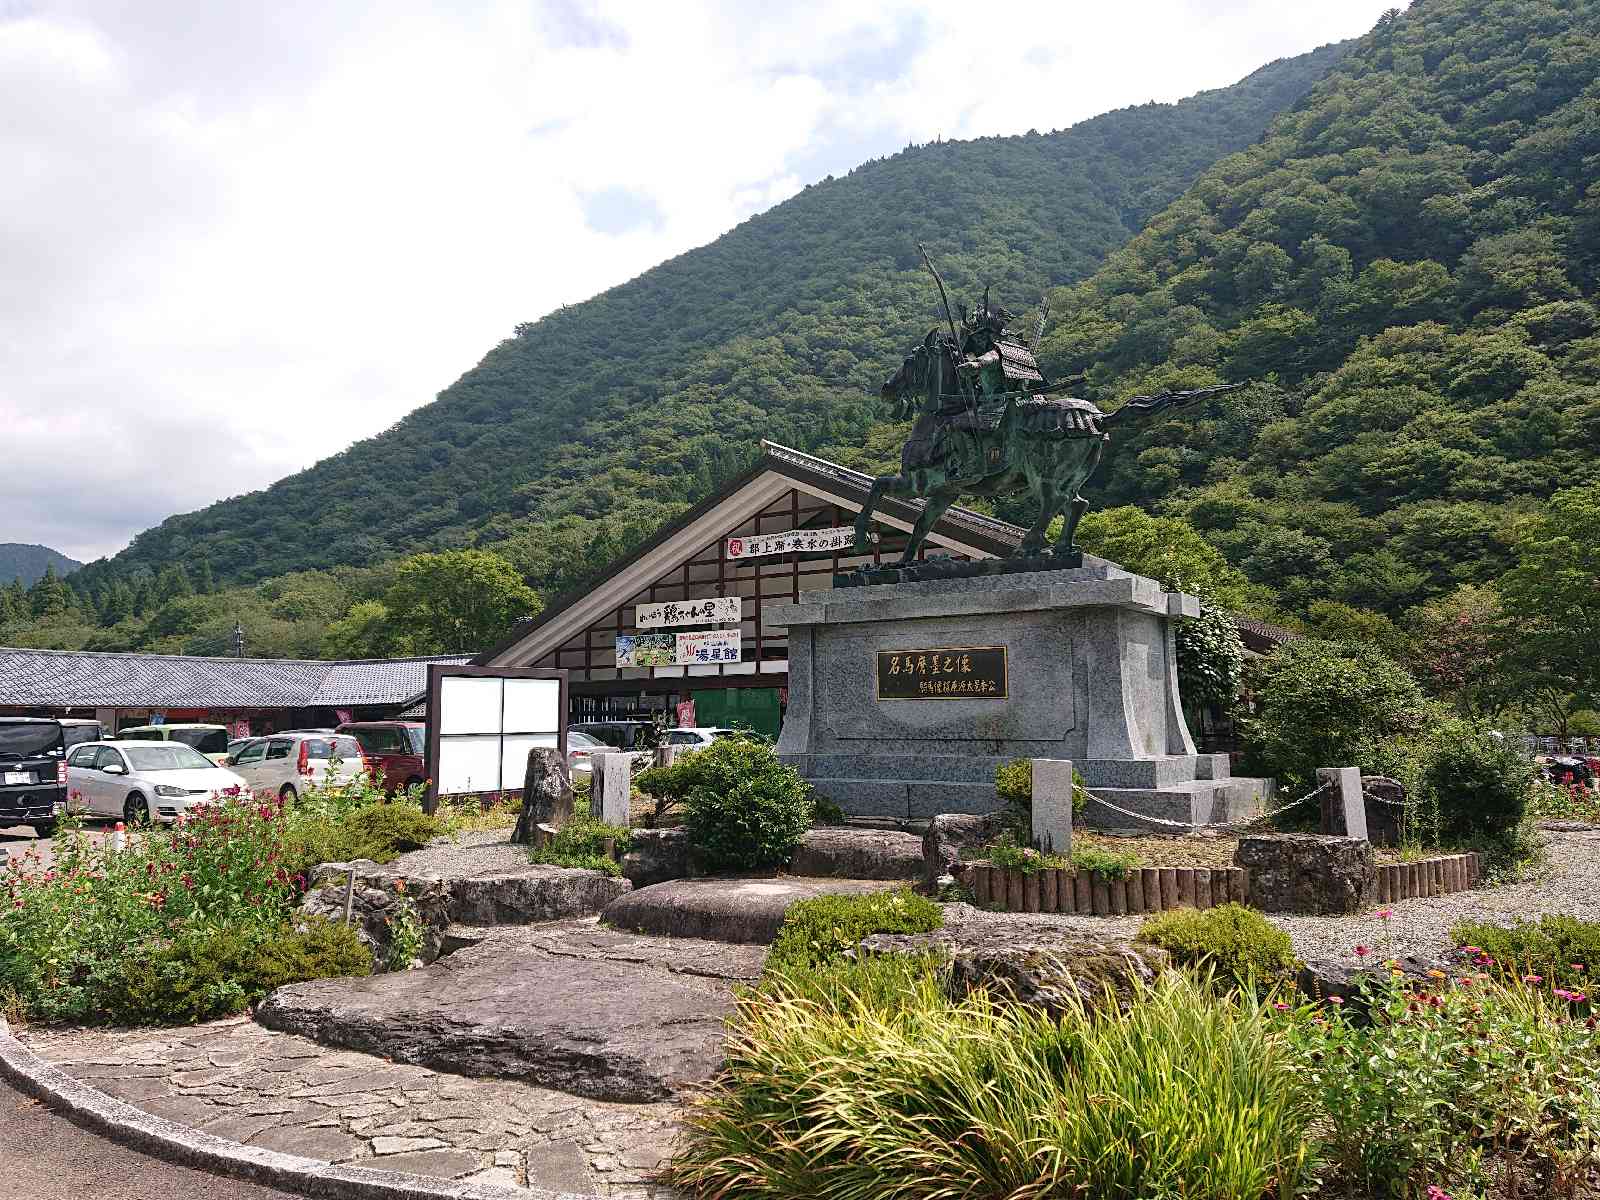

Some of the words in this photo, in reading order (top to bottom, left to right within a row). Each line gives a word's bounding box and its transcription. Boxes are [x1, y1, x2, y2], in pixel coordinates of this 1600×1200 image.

[730, 539, 742, 556] 祝
[695, 647, 738, 662] 湯星館
